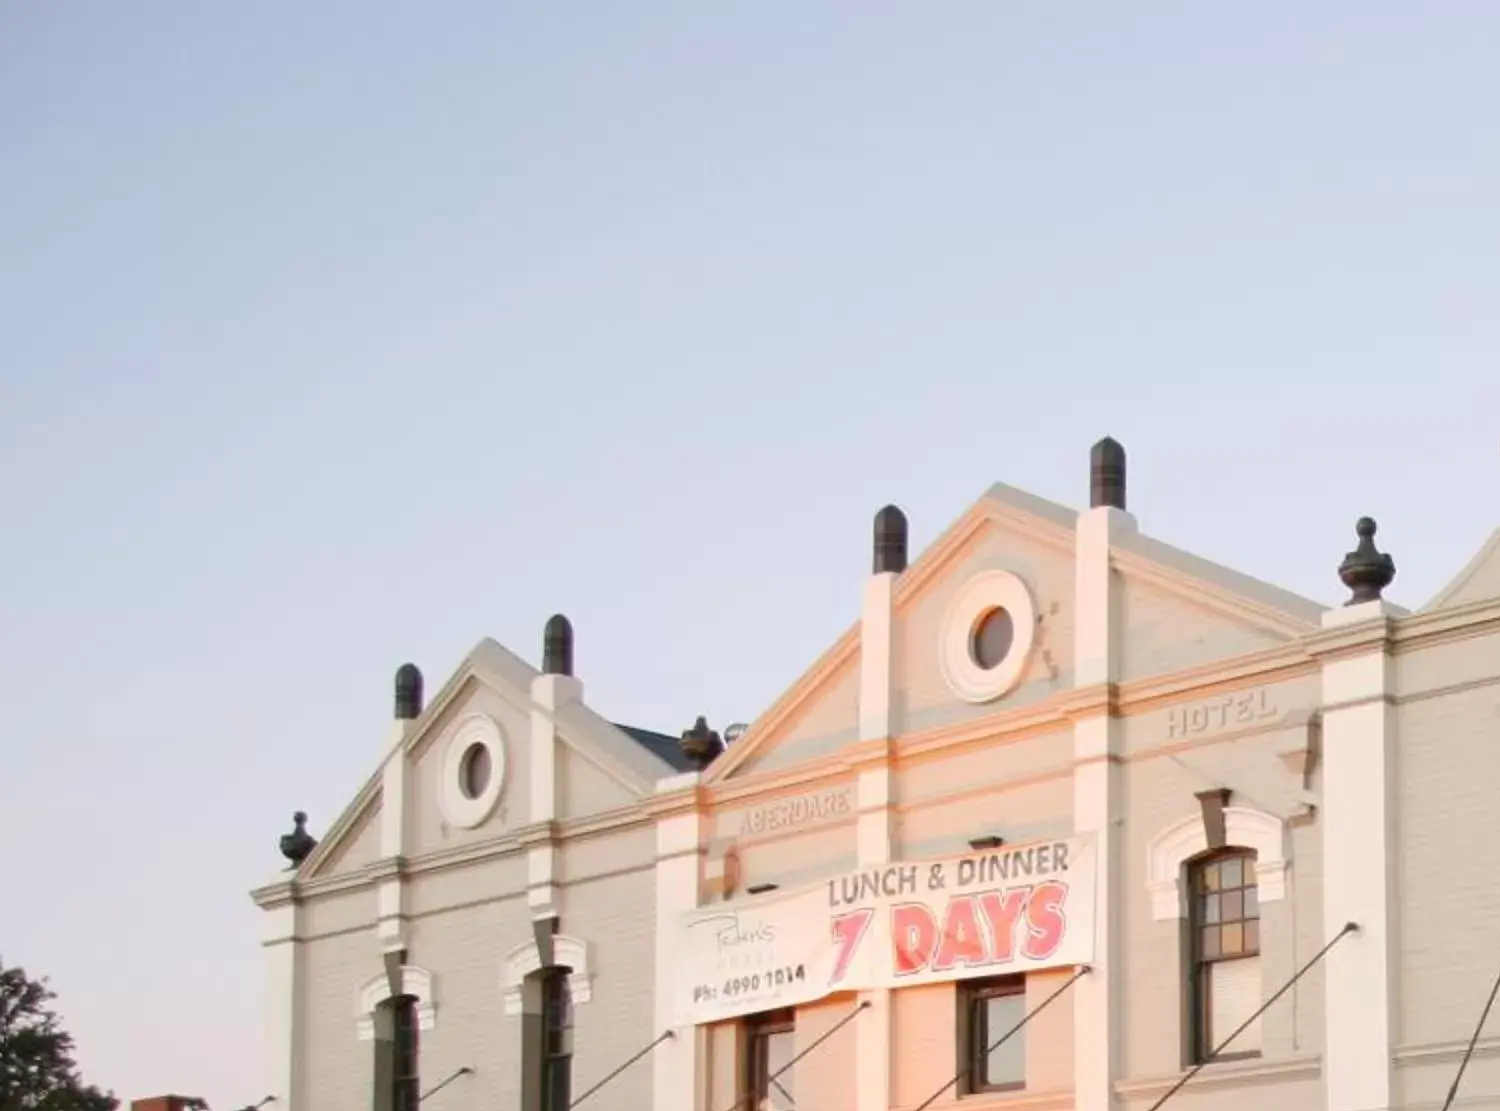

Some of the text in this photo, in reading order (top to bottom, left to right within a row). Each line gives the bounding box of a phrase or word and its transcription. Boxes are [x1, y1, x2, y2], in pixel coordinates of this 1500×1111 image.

[1165, 690, 1278, 739] HOTEL
[828, 842, 1070, 907] LUNCH & DINNER
[827, 879, 1071, 987] 7 DAYS
[693, 982, 718, 1004] Ph:
[722, 971, 761, 998] 4990
[765, 962, 807, 988] 1014
